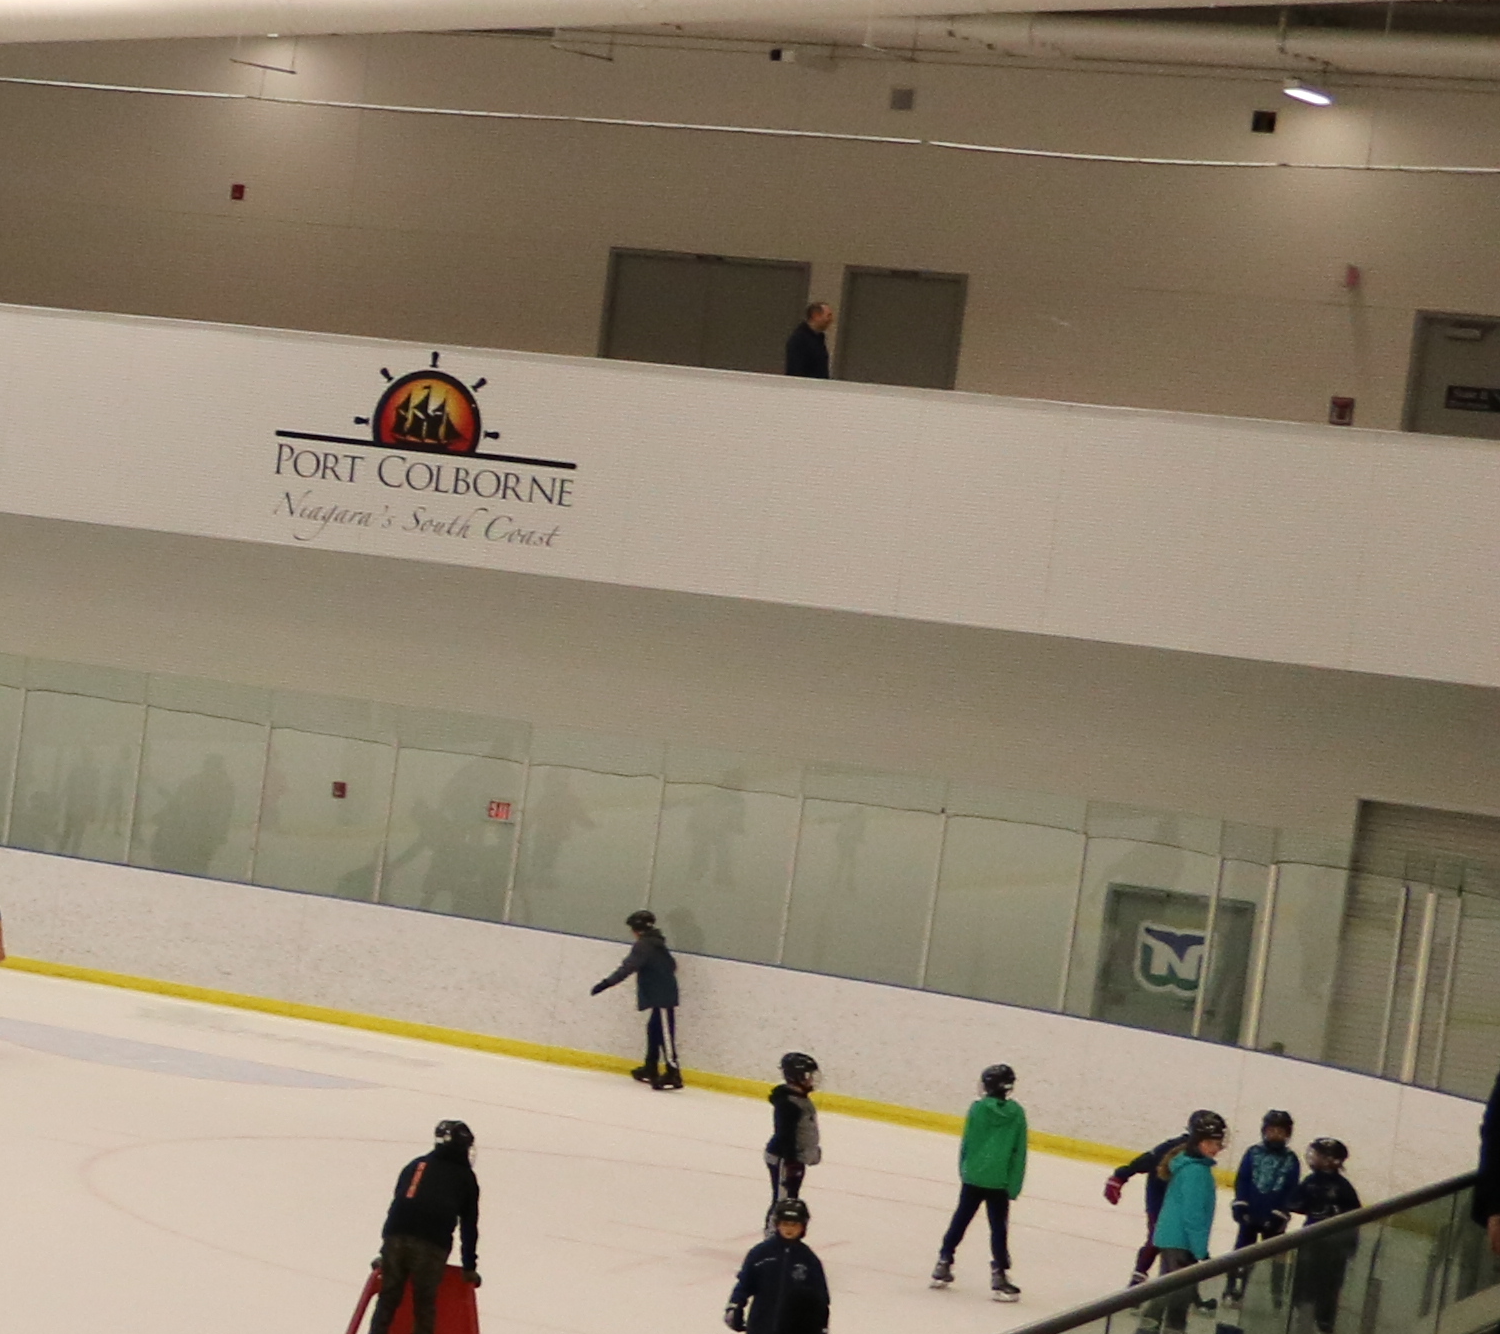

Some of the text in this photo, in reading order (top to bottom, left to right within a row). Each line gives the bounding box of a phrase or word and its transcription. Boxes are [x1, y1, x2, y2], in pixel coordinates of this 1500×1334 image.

[275, 443, 574, 508] PORT COLBORNE
[273, 490, 561, 548] Niagara's South Coast
